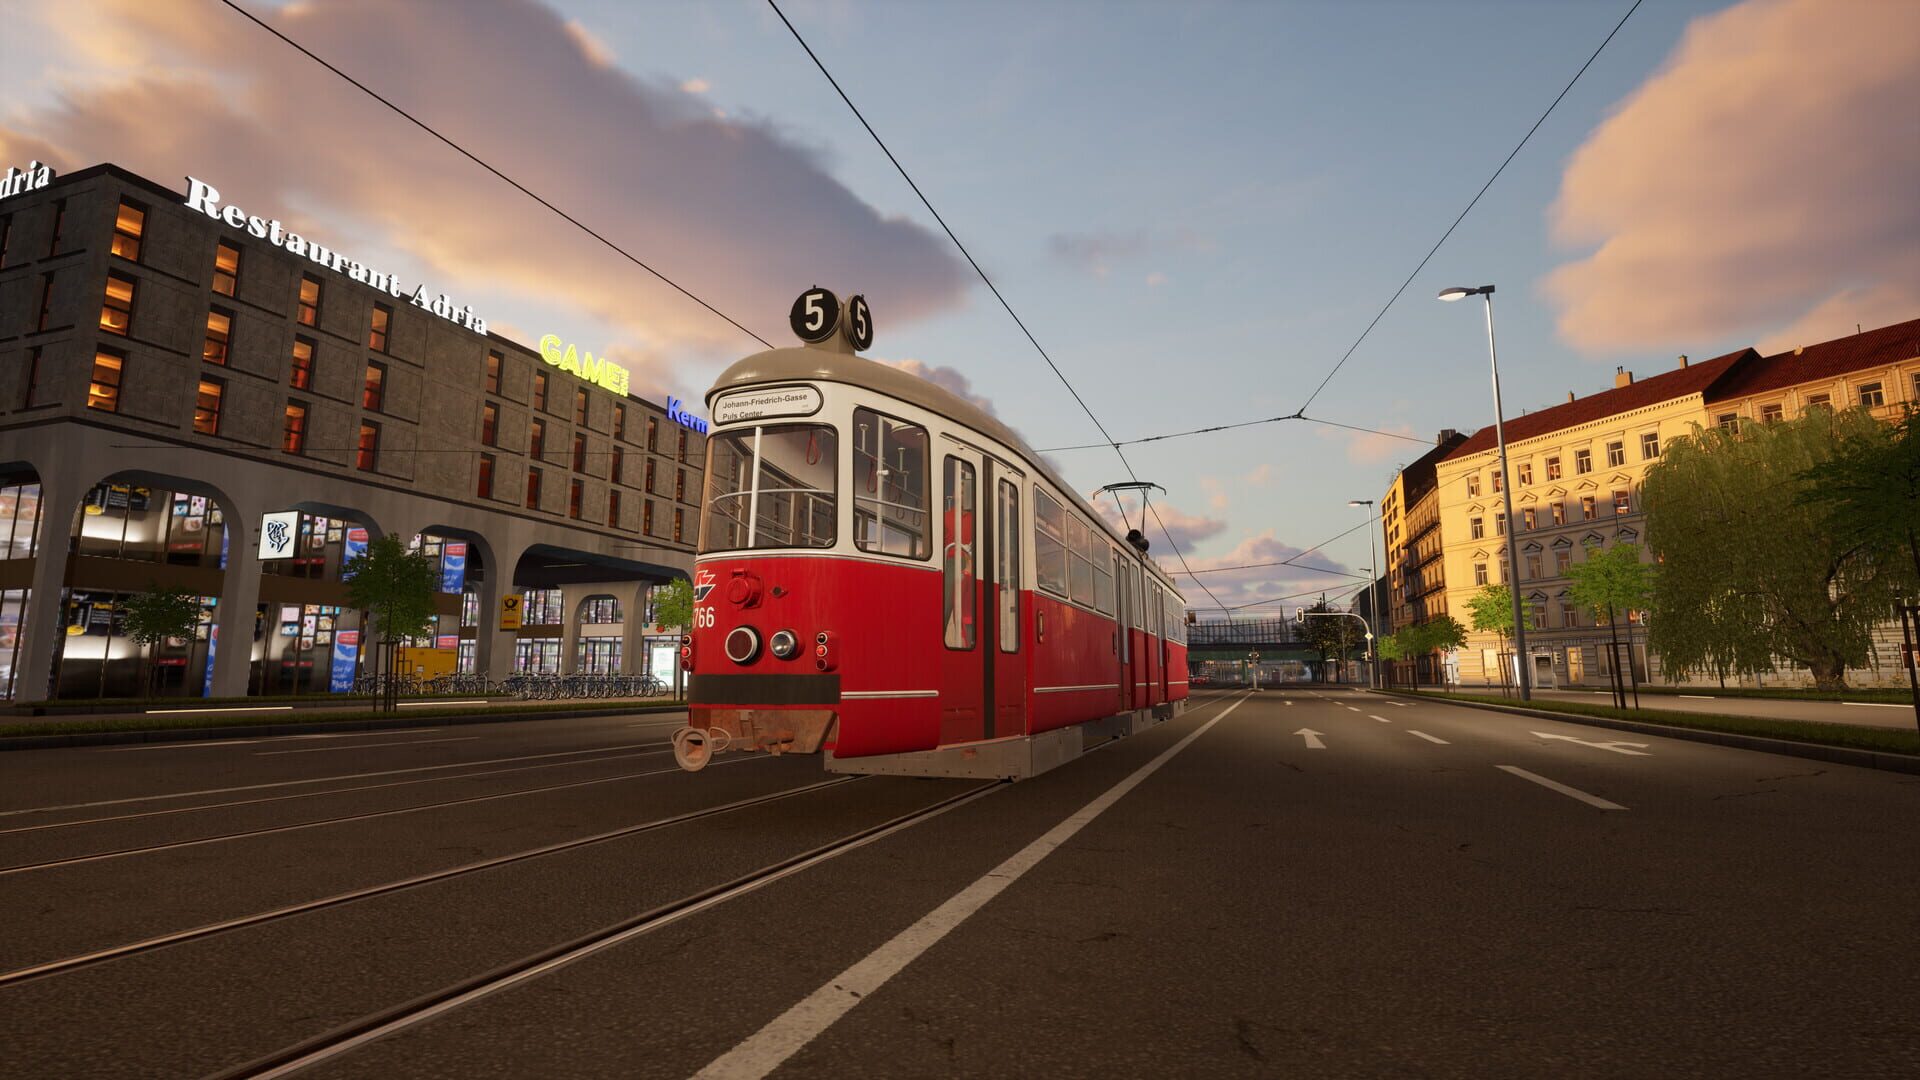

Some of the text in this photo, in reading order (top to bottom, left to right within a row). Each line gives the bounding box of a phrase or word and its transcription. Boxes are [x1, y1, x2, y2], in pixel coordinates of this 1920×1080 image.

[184, 176, 488, 336] Restaurant Adria
[805, 293, 824, 331] 5
[857, 300, 867, 340] 5
[723, 394, 808, 409] Johann-Friedrich-Gasse
[723, 410, 764, 420] Puls Center
[692, 606, 715, 629] 766
